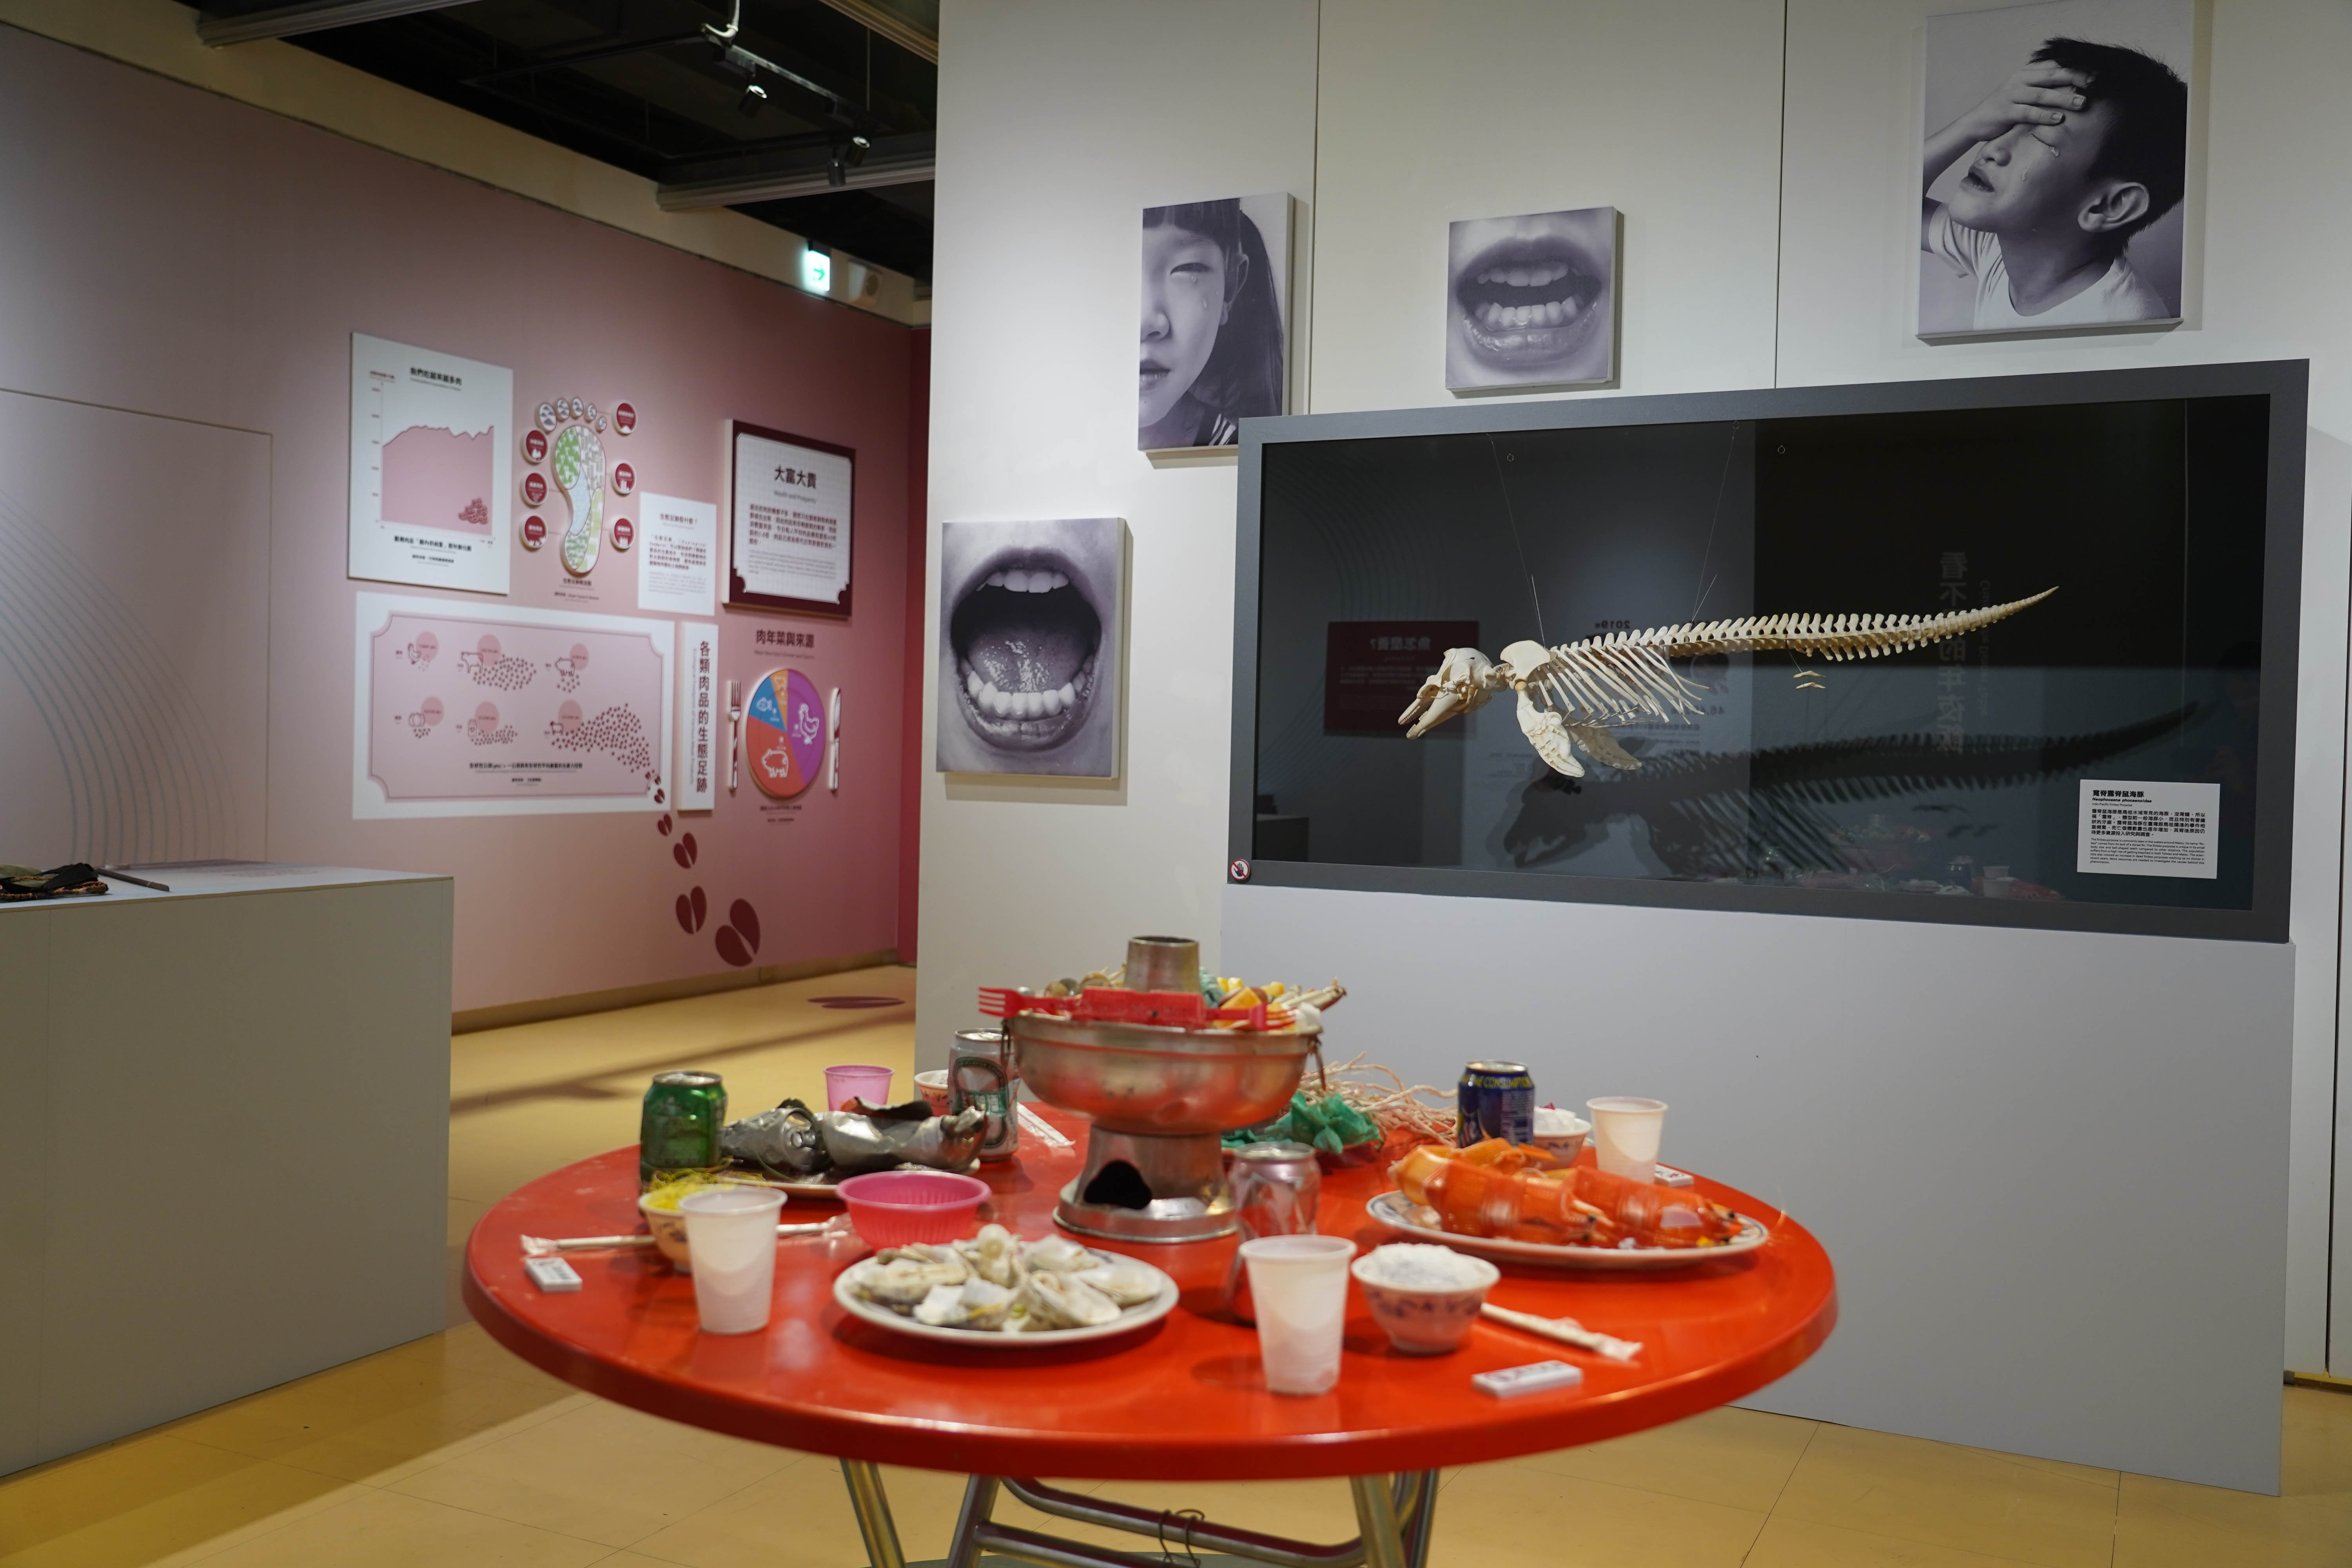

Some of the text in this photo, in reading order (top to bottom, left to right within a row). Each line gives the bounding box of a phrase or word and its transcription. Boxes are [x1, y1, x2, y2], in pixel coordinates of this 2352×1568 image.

[775, 464, 817, 488] 大富大貴
[697, 641, 710, 793] 各類肉品的生態足跡
[2092, 789, 2144, 798] 寬脊露脊鼠海豚
